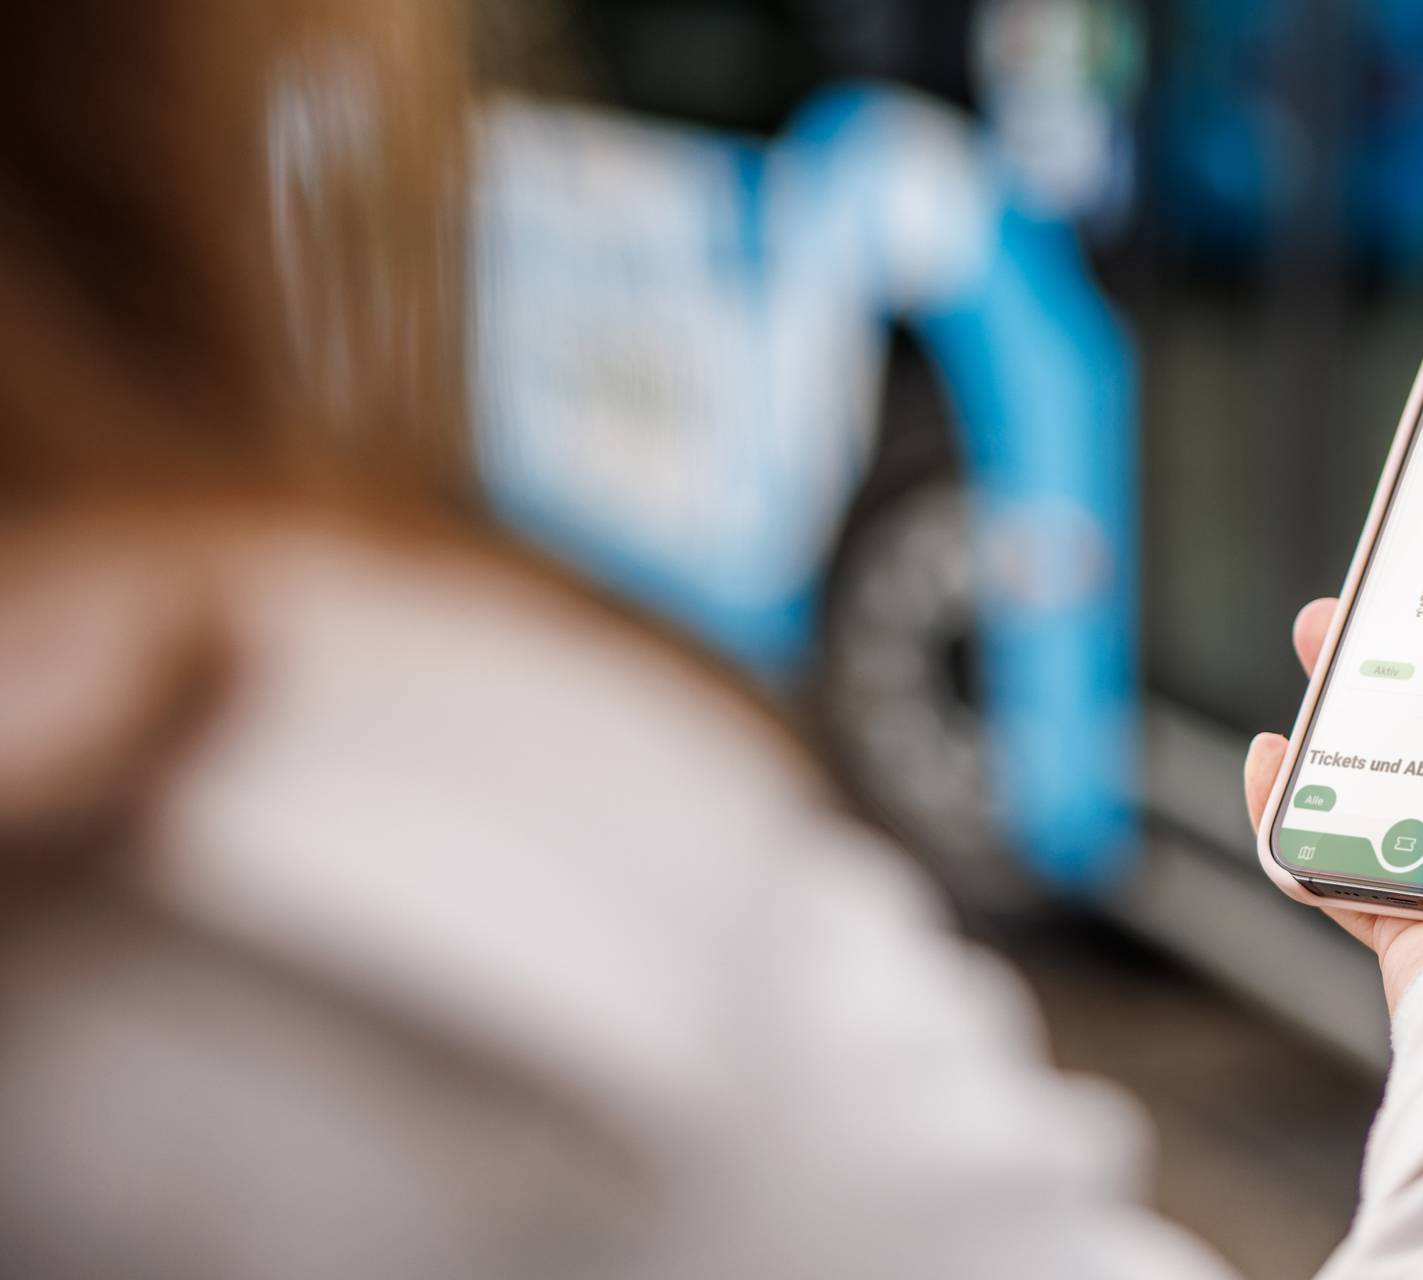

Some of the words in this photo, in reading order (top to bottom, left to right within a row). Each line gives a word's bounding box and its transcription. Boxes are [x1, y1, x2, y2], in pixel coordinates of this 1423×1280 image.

[1373, 665, 1399, 677] Aktiv
[1309, 749, 1367, 770] Tickets
[1370, 758, 1402, 774] und
